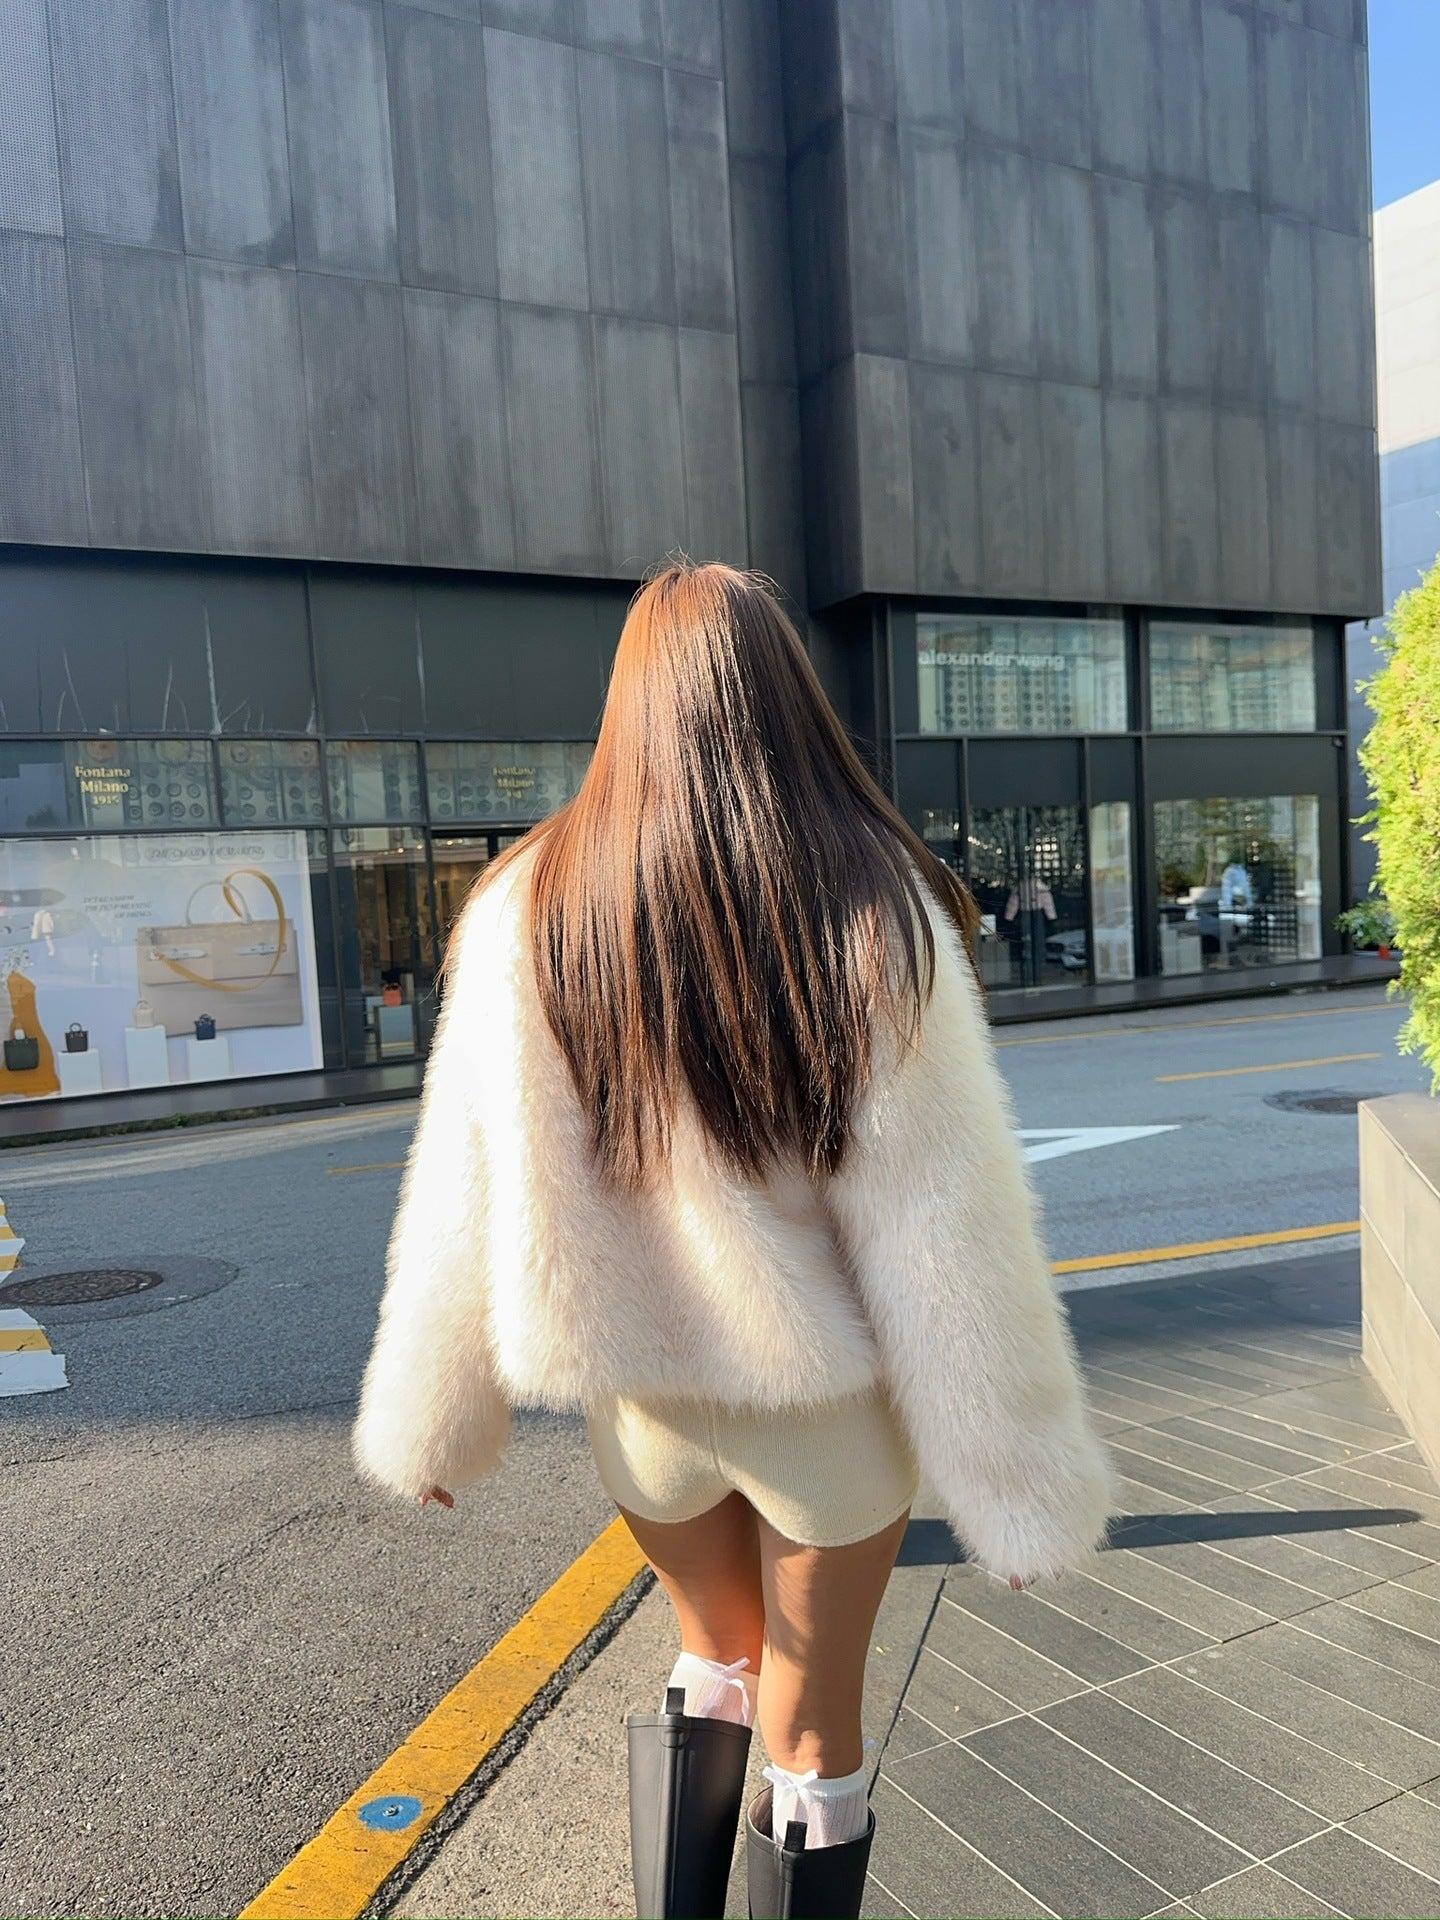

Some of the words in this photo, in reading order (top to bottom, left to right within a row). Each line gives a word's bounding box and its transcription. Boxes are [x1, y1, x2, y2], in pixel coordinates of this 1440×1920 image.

[917, 649, 1065, 671] alexanderwang
[75, 765, 131, 778] Fontana
[81, 780, 129, 793] Milano
